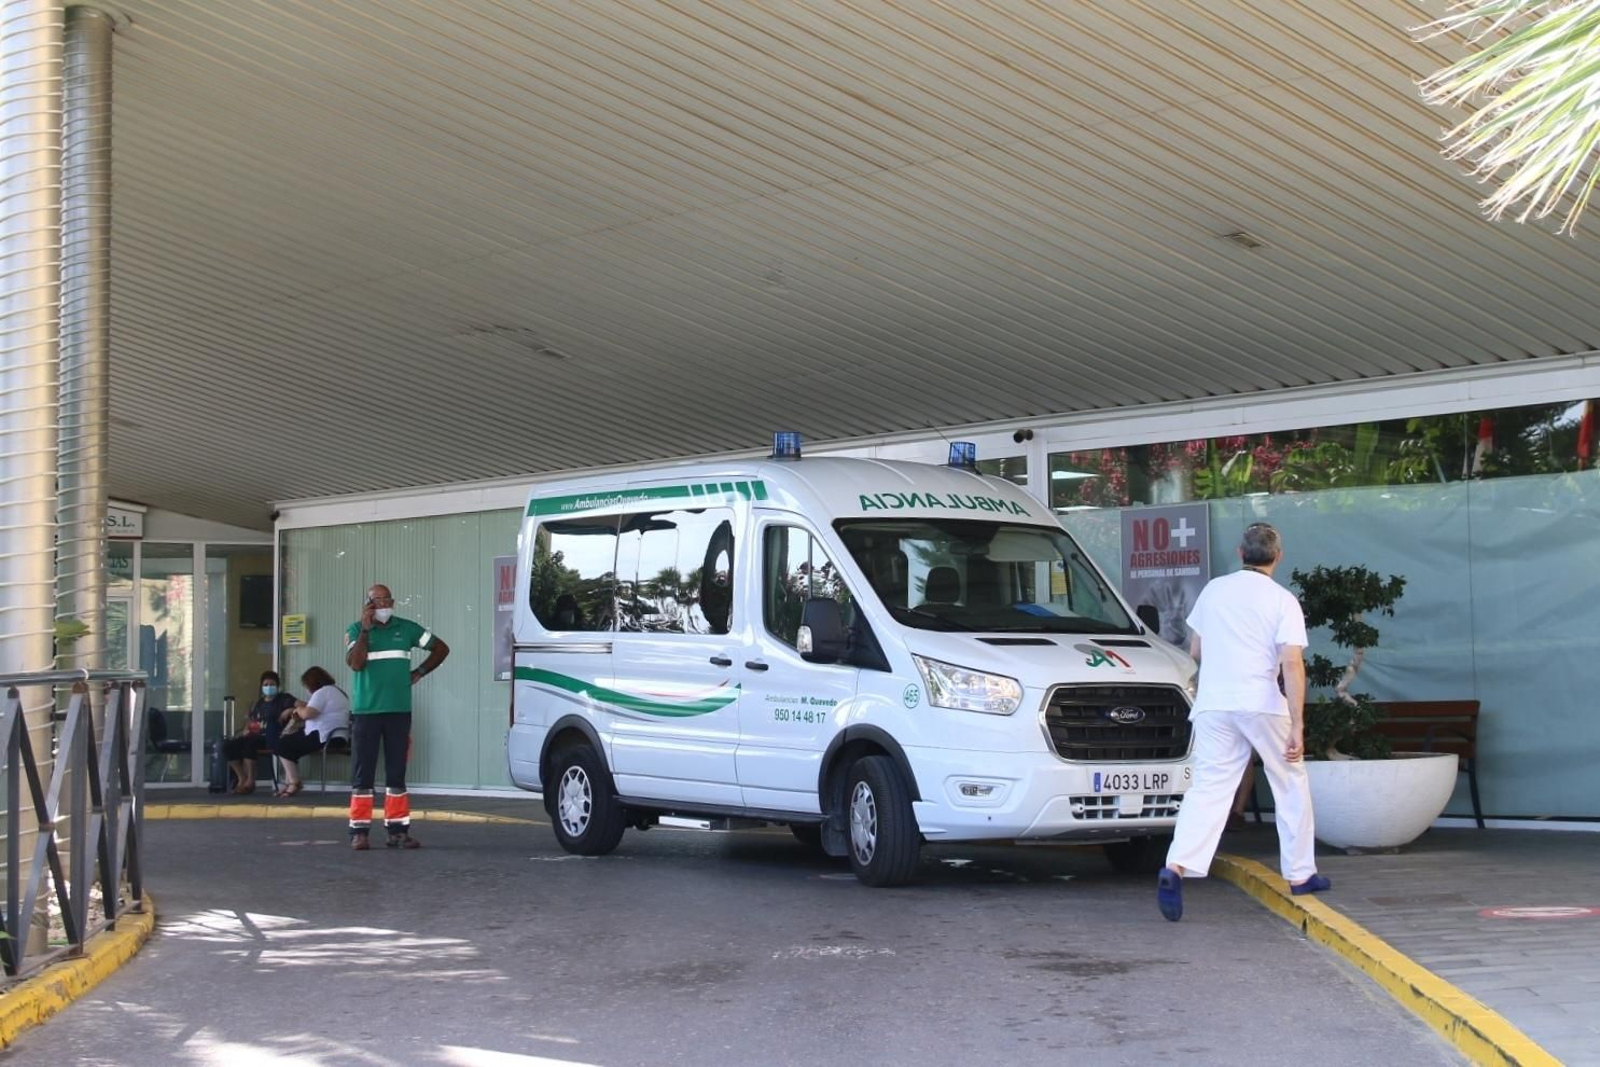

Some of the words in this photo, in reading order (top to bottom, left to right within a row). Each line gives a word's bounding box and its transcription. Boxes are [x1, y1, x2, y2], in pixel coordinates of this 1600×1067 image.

[1130, 550, 1200, 569] AGRESIONES
[810, 697, 838, 706] Quevedo
[905, 689, 918, 703] 465
[774, 708, 790, 721] 950
[792, 710, 801, 722] 14
[803, 711, 814, 723] 48
[816, 712, 826, 724] 17
[1119, 708, 1139, 720] Ford
[1103, 774, 1140, 790] 4033
[1143, 773, 1169, 790] LRP
